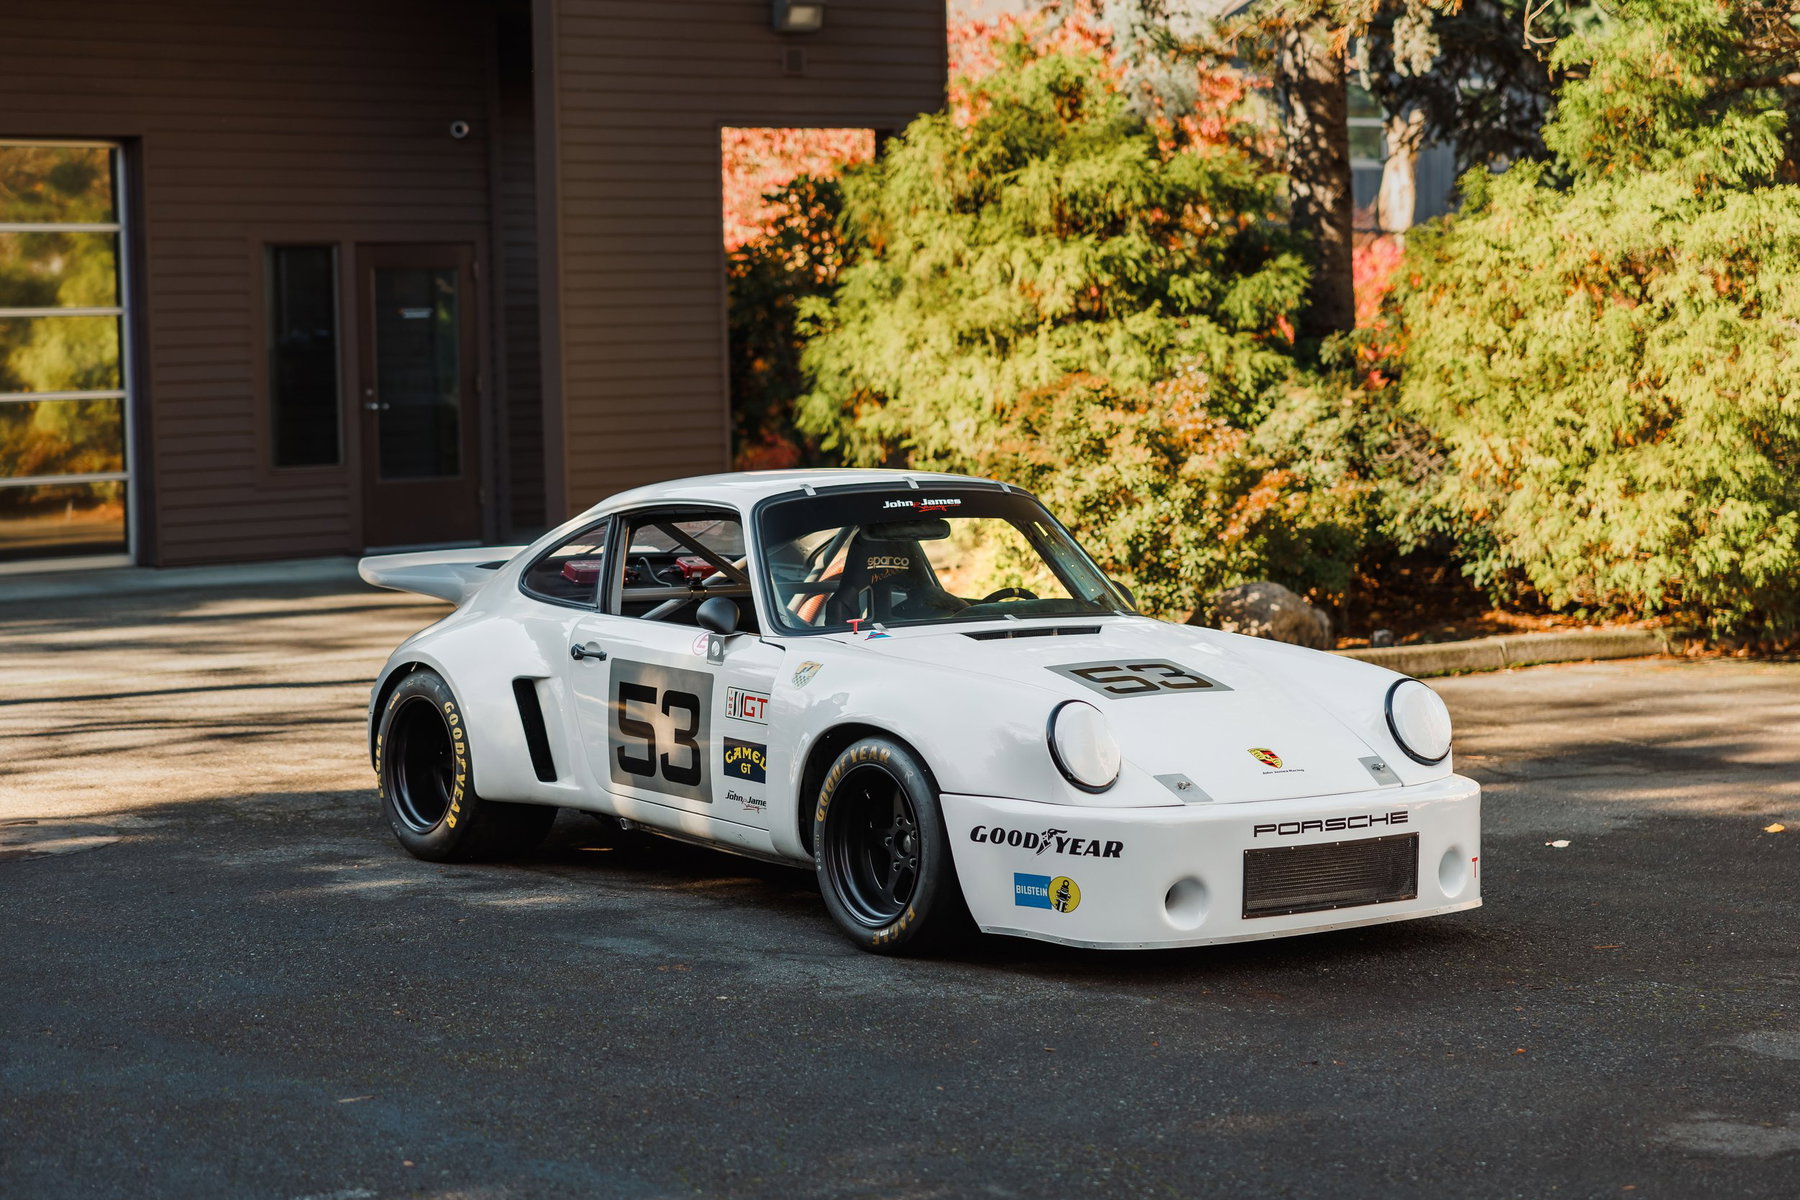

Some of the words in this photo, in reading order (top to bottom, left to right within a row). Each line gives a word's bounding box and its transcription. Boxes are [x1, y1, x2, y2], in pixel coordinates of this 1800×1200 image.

[883, 500, 914, 509] John
[920, 498, 962, 506] James
[867, 556, 910, 569] sparco
[1069, 663, 1214, 695] 53
[743, 695, 768, 719] GT
[616, 681, 702, 787] 53
[443, 701, 468, 829] GOODYEAR
[725, 746, 767, 771] CAMEL
[740, 762, 752, 775] GT
[816, 745, 891, 823] GOODYEAR
[725, 792, 744, 802] John
[746, 796, 767, 807] Jame
[1253, 811, 1409, 837] PORSCHE
[970, 825, 1124, 858] GOODYEAR
[1016, 884, 1048, 897] BILSTEIN
